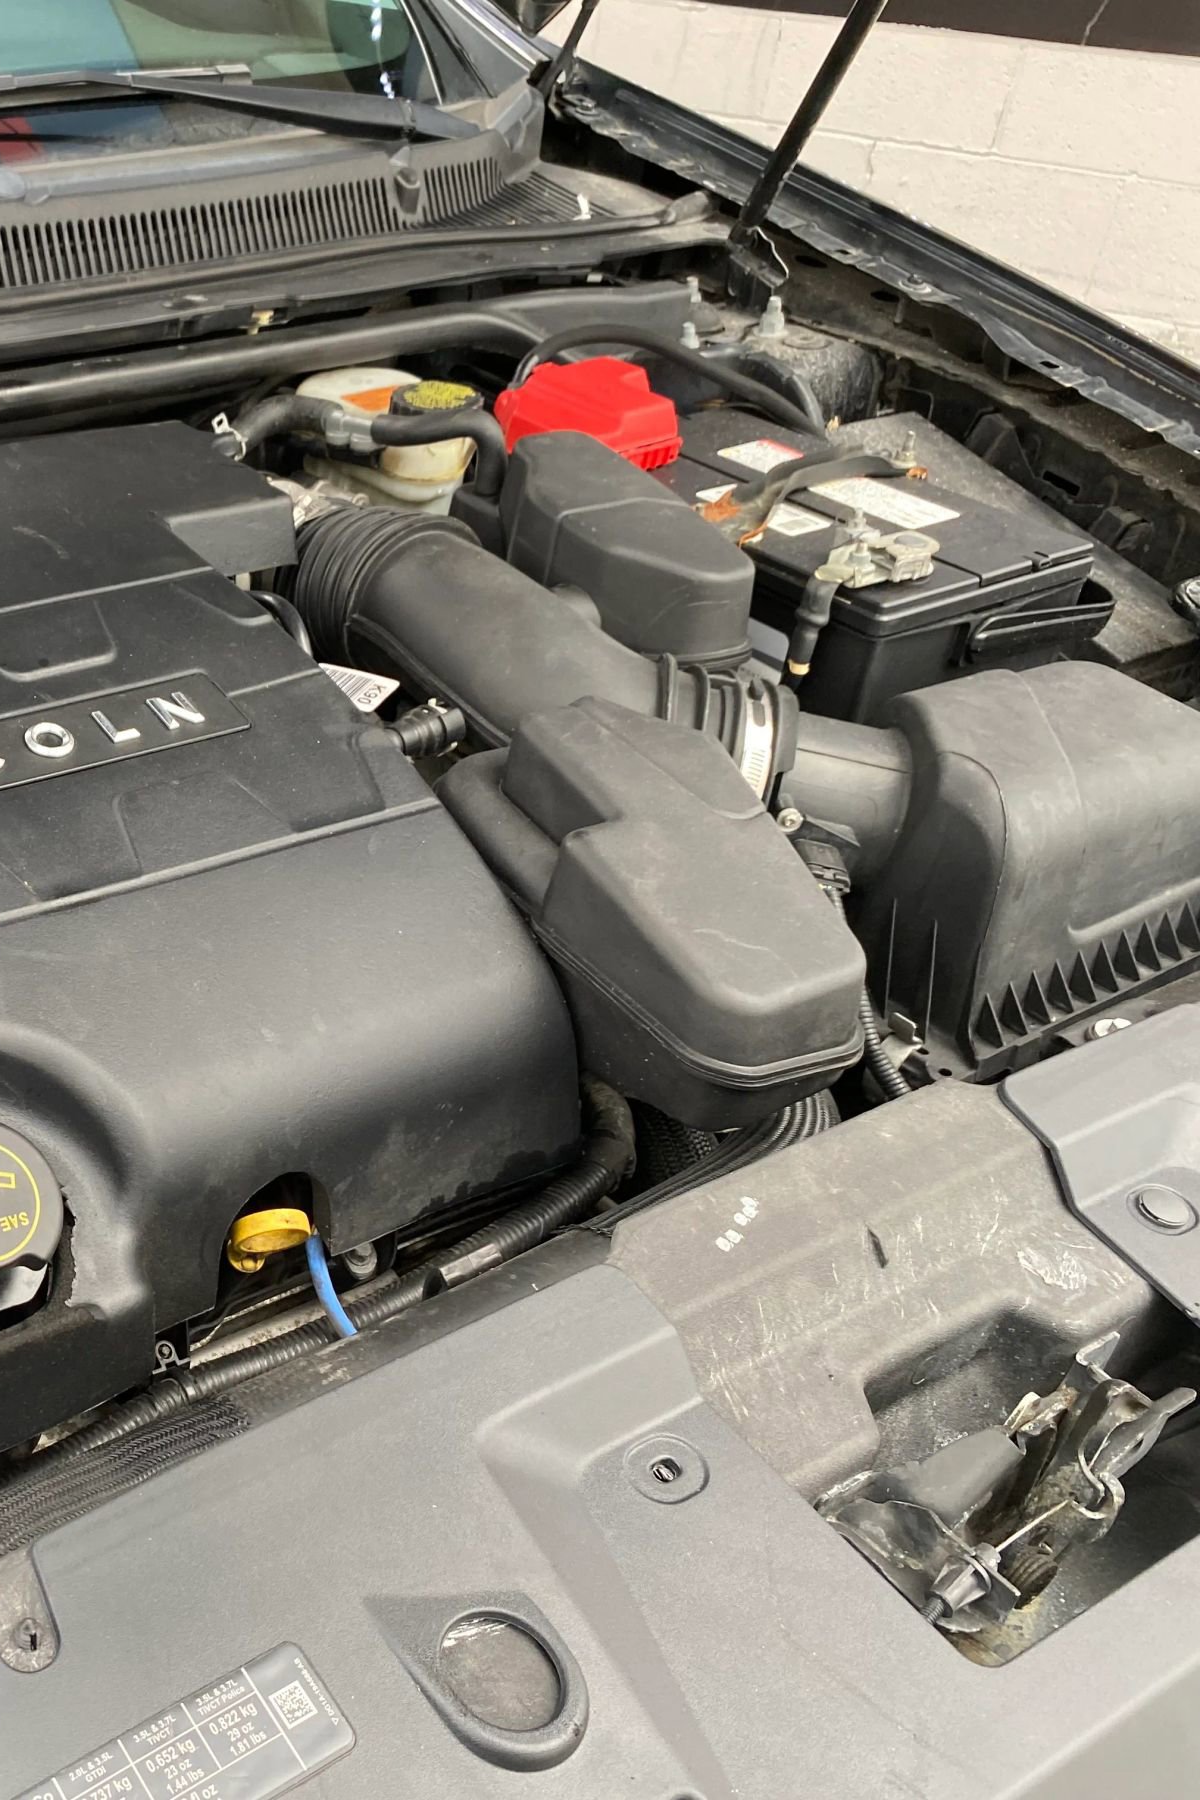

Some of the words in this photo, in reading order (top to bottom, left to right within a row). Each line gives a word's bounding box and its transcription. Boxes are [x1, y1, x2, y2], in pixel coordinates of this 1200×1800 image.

[0, 1211, 30, 1231] SAE
[196, 1693, 213, 1706] 3.5L
[213, 1687, 220, 1696] &
[220, 1679, 238, 1692] 3.7L
[221, 1686, 245, 1703] Police
[133, 1729, 151, 1743] 3.5L
[150, 1723, 158, 1732] &
[158, 1714, 177, 1728] 3.7L
[208, 1709, 241, 1735] 0.822
[238, 1702, 258, 1718] kg
[227, 1727, 241, 1742] 29
[241, 1721, 255, 1734] oz
[145, 1746, 178, 1773] 0.652
[176, 1739, 196, 1754] kg
[230, 1738, 251, 1757] 1.81
[250, 1730, 267, 1745] lbs
[68, 1767, 87, 1782] 2.0L
[87, 1761, 95, 1771] &
[94, 1751, 114, 1765] 3.5L
[164, 1764, 178, 1779] 23
[179, 1759, 192, 1772] oz
[112, 1776, 132, 1792] kg
[166, 1775, 188, 1795] 1.44
[186, 1768, 205, 1783] lbs
[202, 1784, 219, 1800] oz
